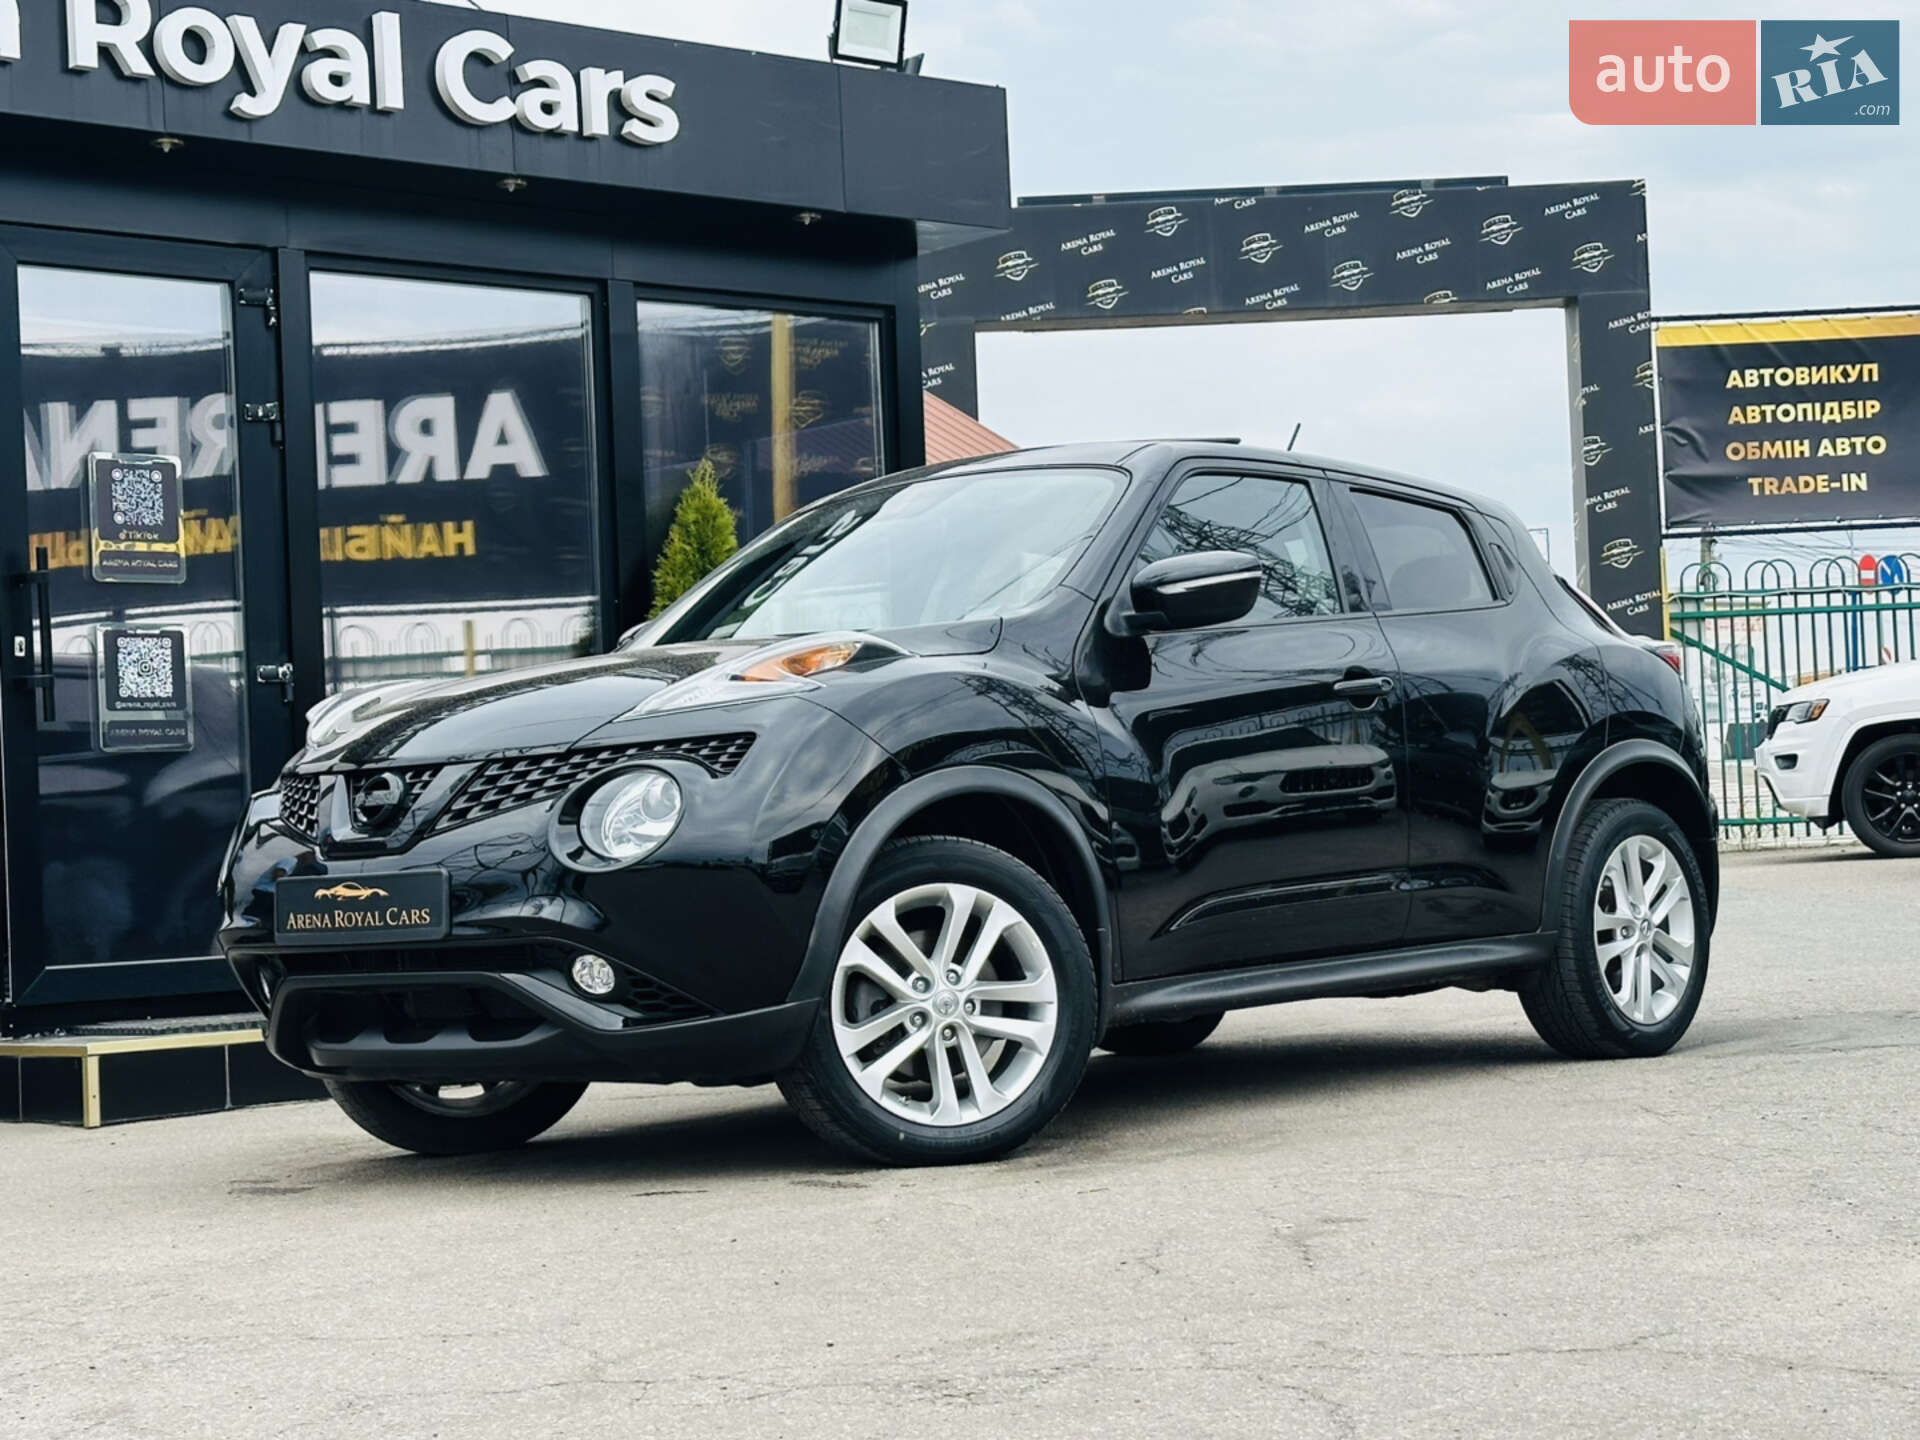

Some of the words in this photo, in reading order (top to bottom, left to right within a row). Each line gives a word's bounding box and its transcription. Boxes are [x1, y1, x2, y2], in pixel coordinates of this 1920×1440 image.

[66, 0, 404, 119] Royal
[434, 29, 680, 146] Cars
[1544, 201, 1571, 216] ARENA
[1572, 193, 1600, 207] ROYAL
[1564, 207, 1588, 220] CARS
[1304, 219, 1331, 234] ARENA
[1332, 211, 1360, 225] ROYAL
[1324, 225, 1347, 238] CARS
[1061, 237, 1088, 251] ARENA
[1088, 229, 1116, 242] ROYAL
[1080, 243, 1103, 255] CARS
[1396, 246, 1423, 260] ARENA
[1424, 237, 1452, 252] ROYAL
[1151, 265, 1178, 279] ARENA
[1179, 257, 1206, 270] ROYAL
[1416, 252, 1439, 264] CARS
[1171, 271, 1193, 283] CARS
[1486, 275, 1513, 290] ARENA
[1514, 267, 1542, 281] ROYAL
[1506, 282, 1529, 294] CARS
[1245, 292, 1272, 306] ARENA
[1273, 283, 1300, 297] ROYAL
[1265, 298, 1288, 310] CARS
[1725, 363, 1879, 389] АВТОВИКУП
[1728, 399, 1881, 425] АВТОПІДБІР
[1725, 439, 1810, 461] ОБМІН
[1817, 435, 1887, 457] АВТО
[1748, 473, 1868, 496] TRADE-IN
[287, 912, 332, 930] ARENA
[334, 910, 384, 928] ROYAL
[386, 907, 431, 926] CARS
